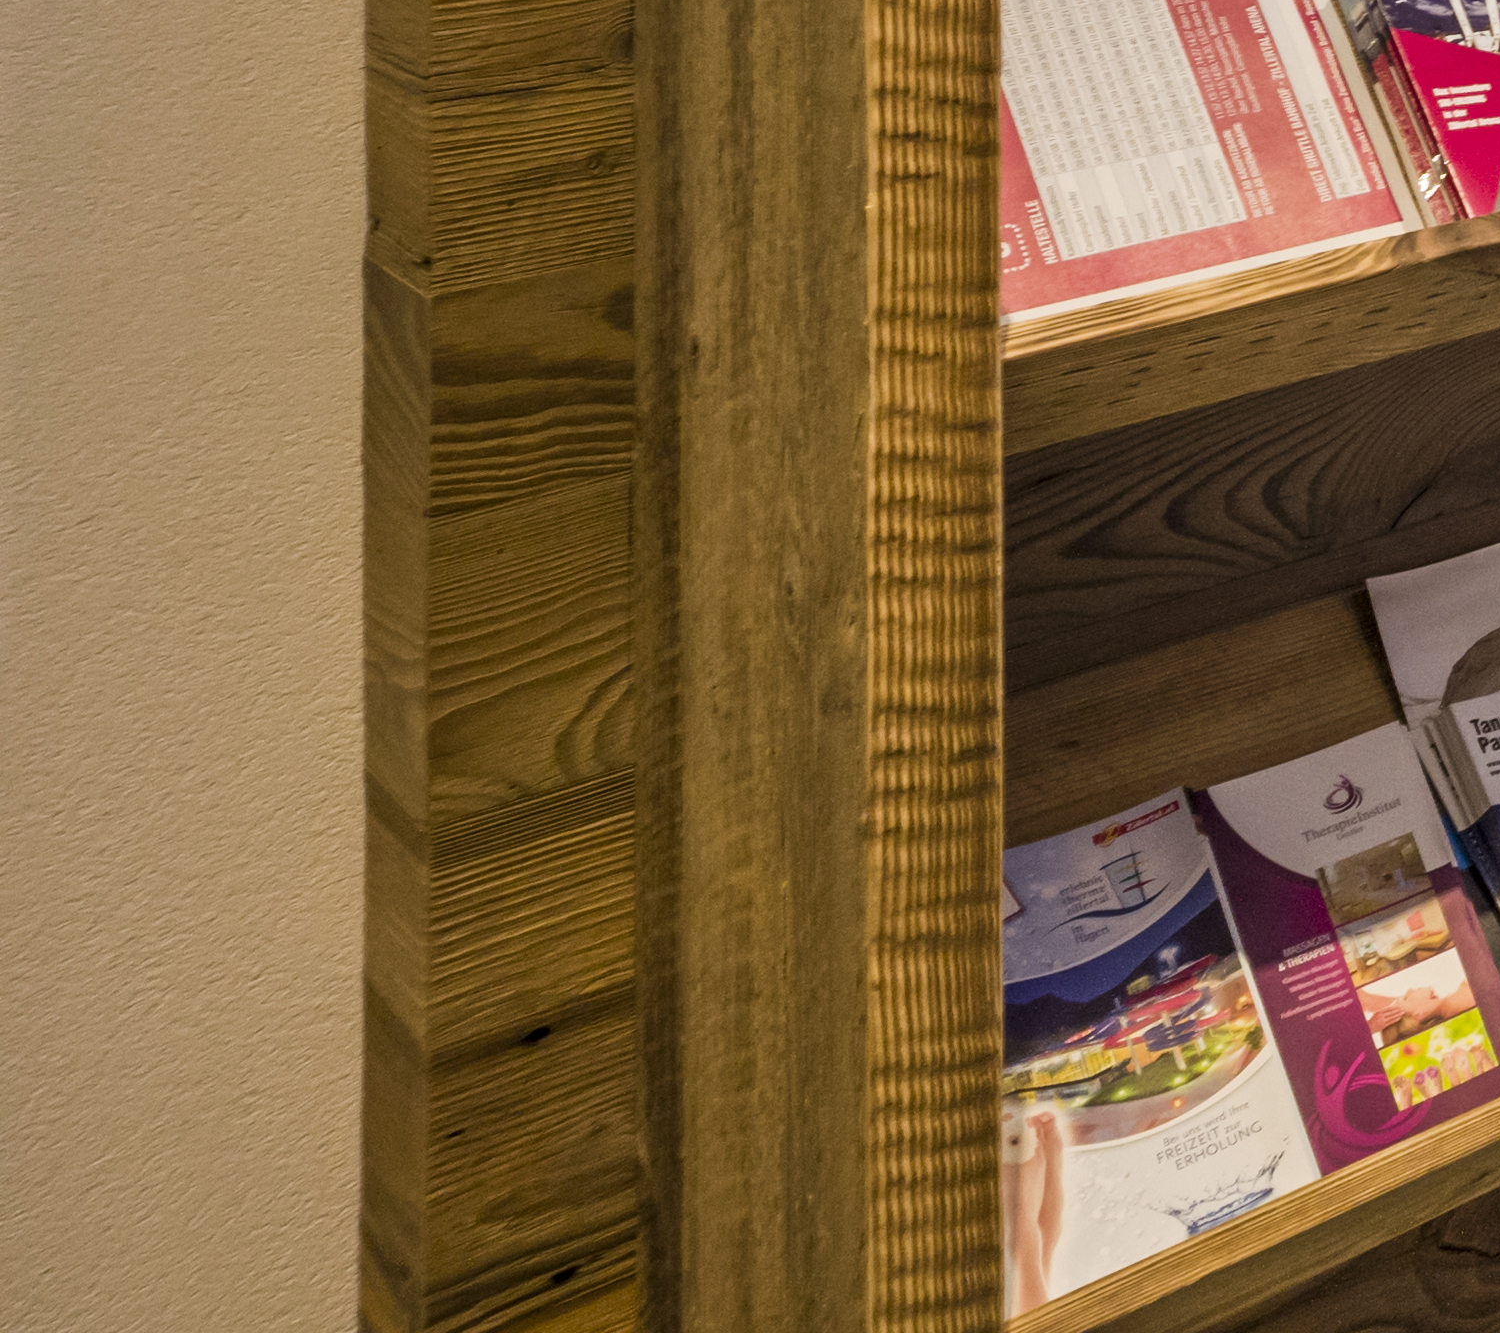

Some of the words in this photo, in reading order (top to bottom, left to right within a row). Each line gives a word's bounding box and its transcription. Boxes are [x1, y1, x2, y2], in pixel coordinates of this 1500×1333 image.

[1245, 4, 1266, 34] ARENA
[1257, 35, 1284, 80] ZILLERTAL
[1276, 86, 1303, 129] BAHNHOF
[1293, 128, 1319, 169] SHUTTLE
[1309, 169, 1332, 202] DIRECT
[1022, 199, 1060, 264] HALTESTELLE
[1302, 798, 1402, 843] TherapieInstitut
[1285, 944, 1335, 969] THERAPIEN
[1156, 1126, 1220, 1165] FREIZEIT
[1176, 1120, 1263, 1172] ERHOLUNG
